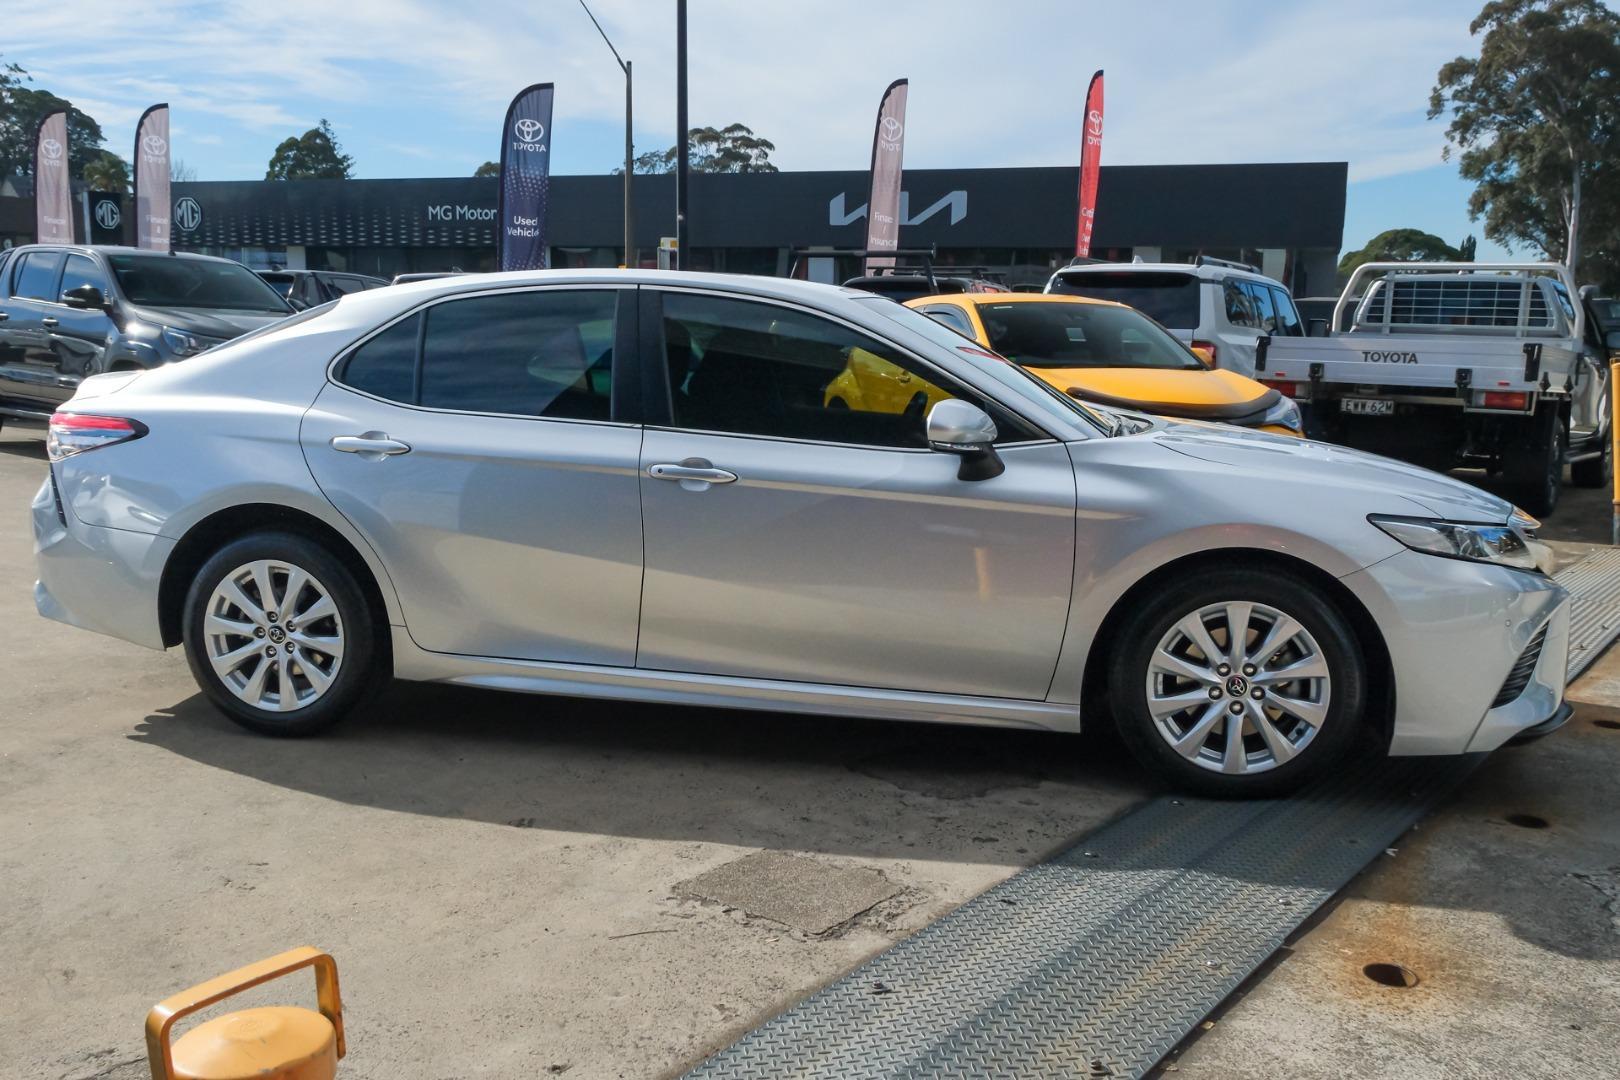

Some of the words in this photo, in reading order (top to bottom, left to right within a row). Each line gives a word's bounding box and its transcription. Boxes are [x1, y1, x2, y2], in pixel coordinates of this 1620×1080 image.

[513, 142, 546, 152] TOYOTA
[97, 202, 119, 228] MG
[175, 200, 200, 229] MG
[428, 206, 452, 220] MG
[456, 205, 497, 220] Motor
[513, 215, 538, 226] Used
[507, 226, 539, 237] Vehicle
[1362, 351, 1418, 364] TOYOTA
